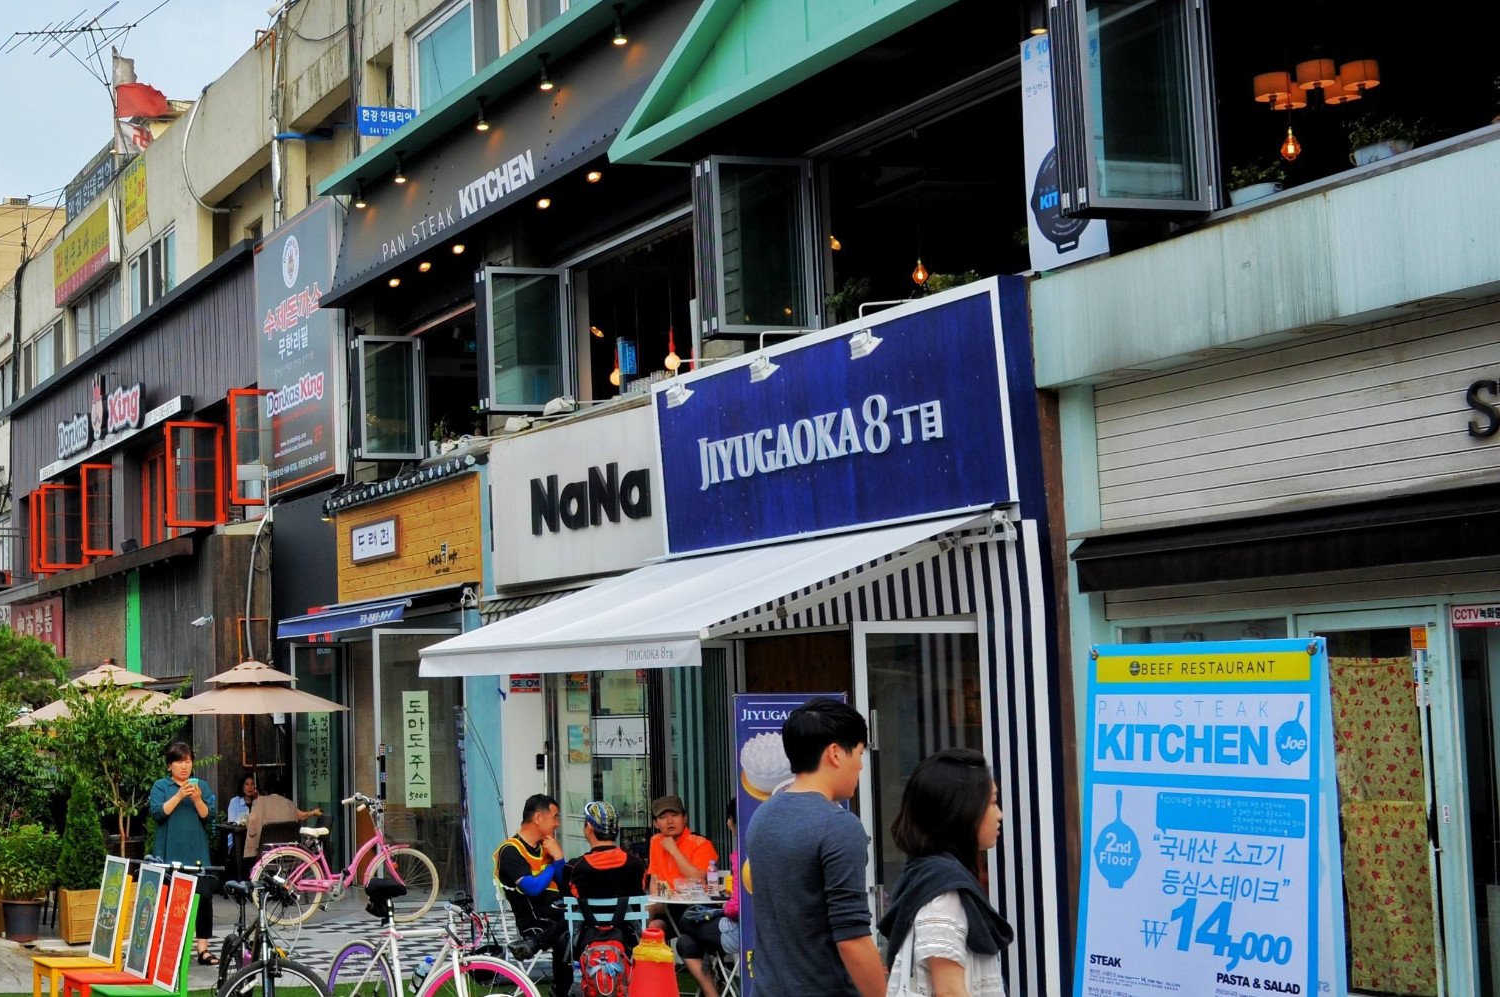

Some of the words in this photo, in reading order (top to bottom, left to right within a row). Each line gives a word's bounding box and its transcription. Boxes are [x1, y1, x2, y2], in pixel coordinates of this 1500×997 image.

[380, 110, 412, 123] 인테리어
[383, 233, 406, 261] PAN
[411, 204, 455, 245] STEAK
[459, 149, 535, 218] KITCHEN
[1040, 191, 1059, 210] KIT
[263, 282, 323, 341] 수제돈까스
[278, 324, 309, 360] 무한리필
[57, 414, 89, 460] Donkas
[107, 384, 142, 434] King
[699, 408, 864, 491] JIYUGAOKA
[530, 462, 652, 537] NaNa
[1141, 661, 1174, 676] BEEF
[1180, 660, 1276, 675] RESTAURANT
[511, 679, 540, 688] SEOM
[1098, 700, 1149, 718] PAN
[1174, 700, 1270, 719] STEAK
[1097, 723, 1269, 766] KITCHEN
[1280, 735, 1308, 751] Joe
[1105, 831, 1132, 854] 2nd
[1099, 852, 1134, 868] Floor
[1223, 842, 1285, 871] 소고기
[1089, 954, 1122, 969] STEAK
[1216, 972, 1250, 988] PASTA
[1252, 978, 1261, 989] &
[1263, 979, 1301, 995] SALAD
